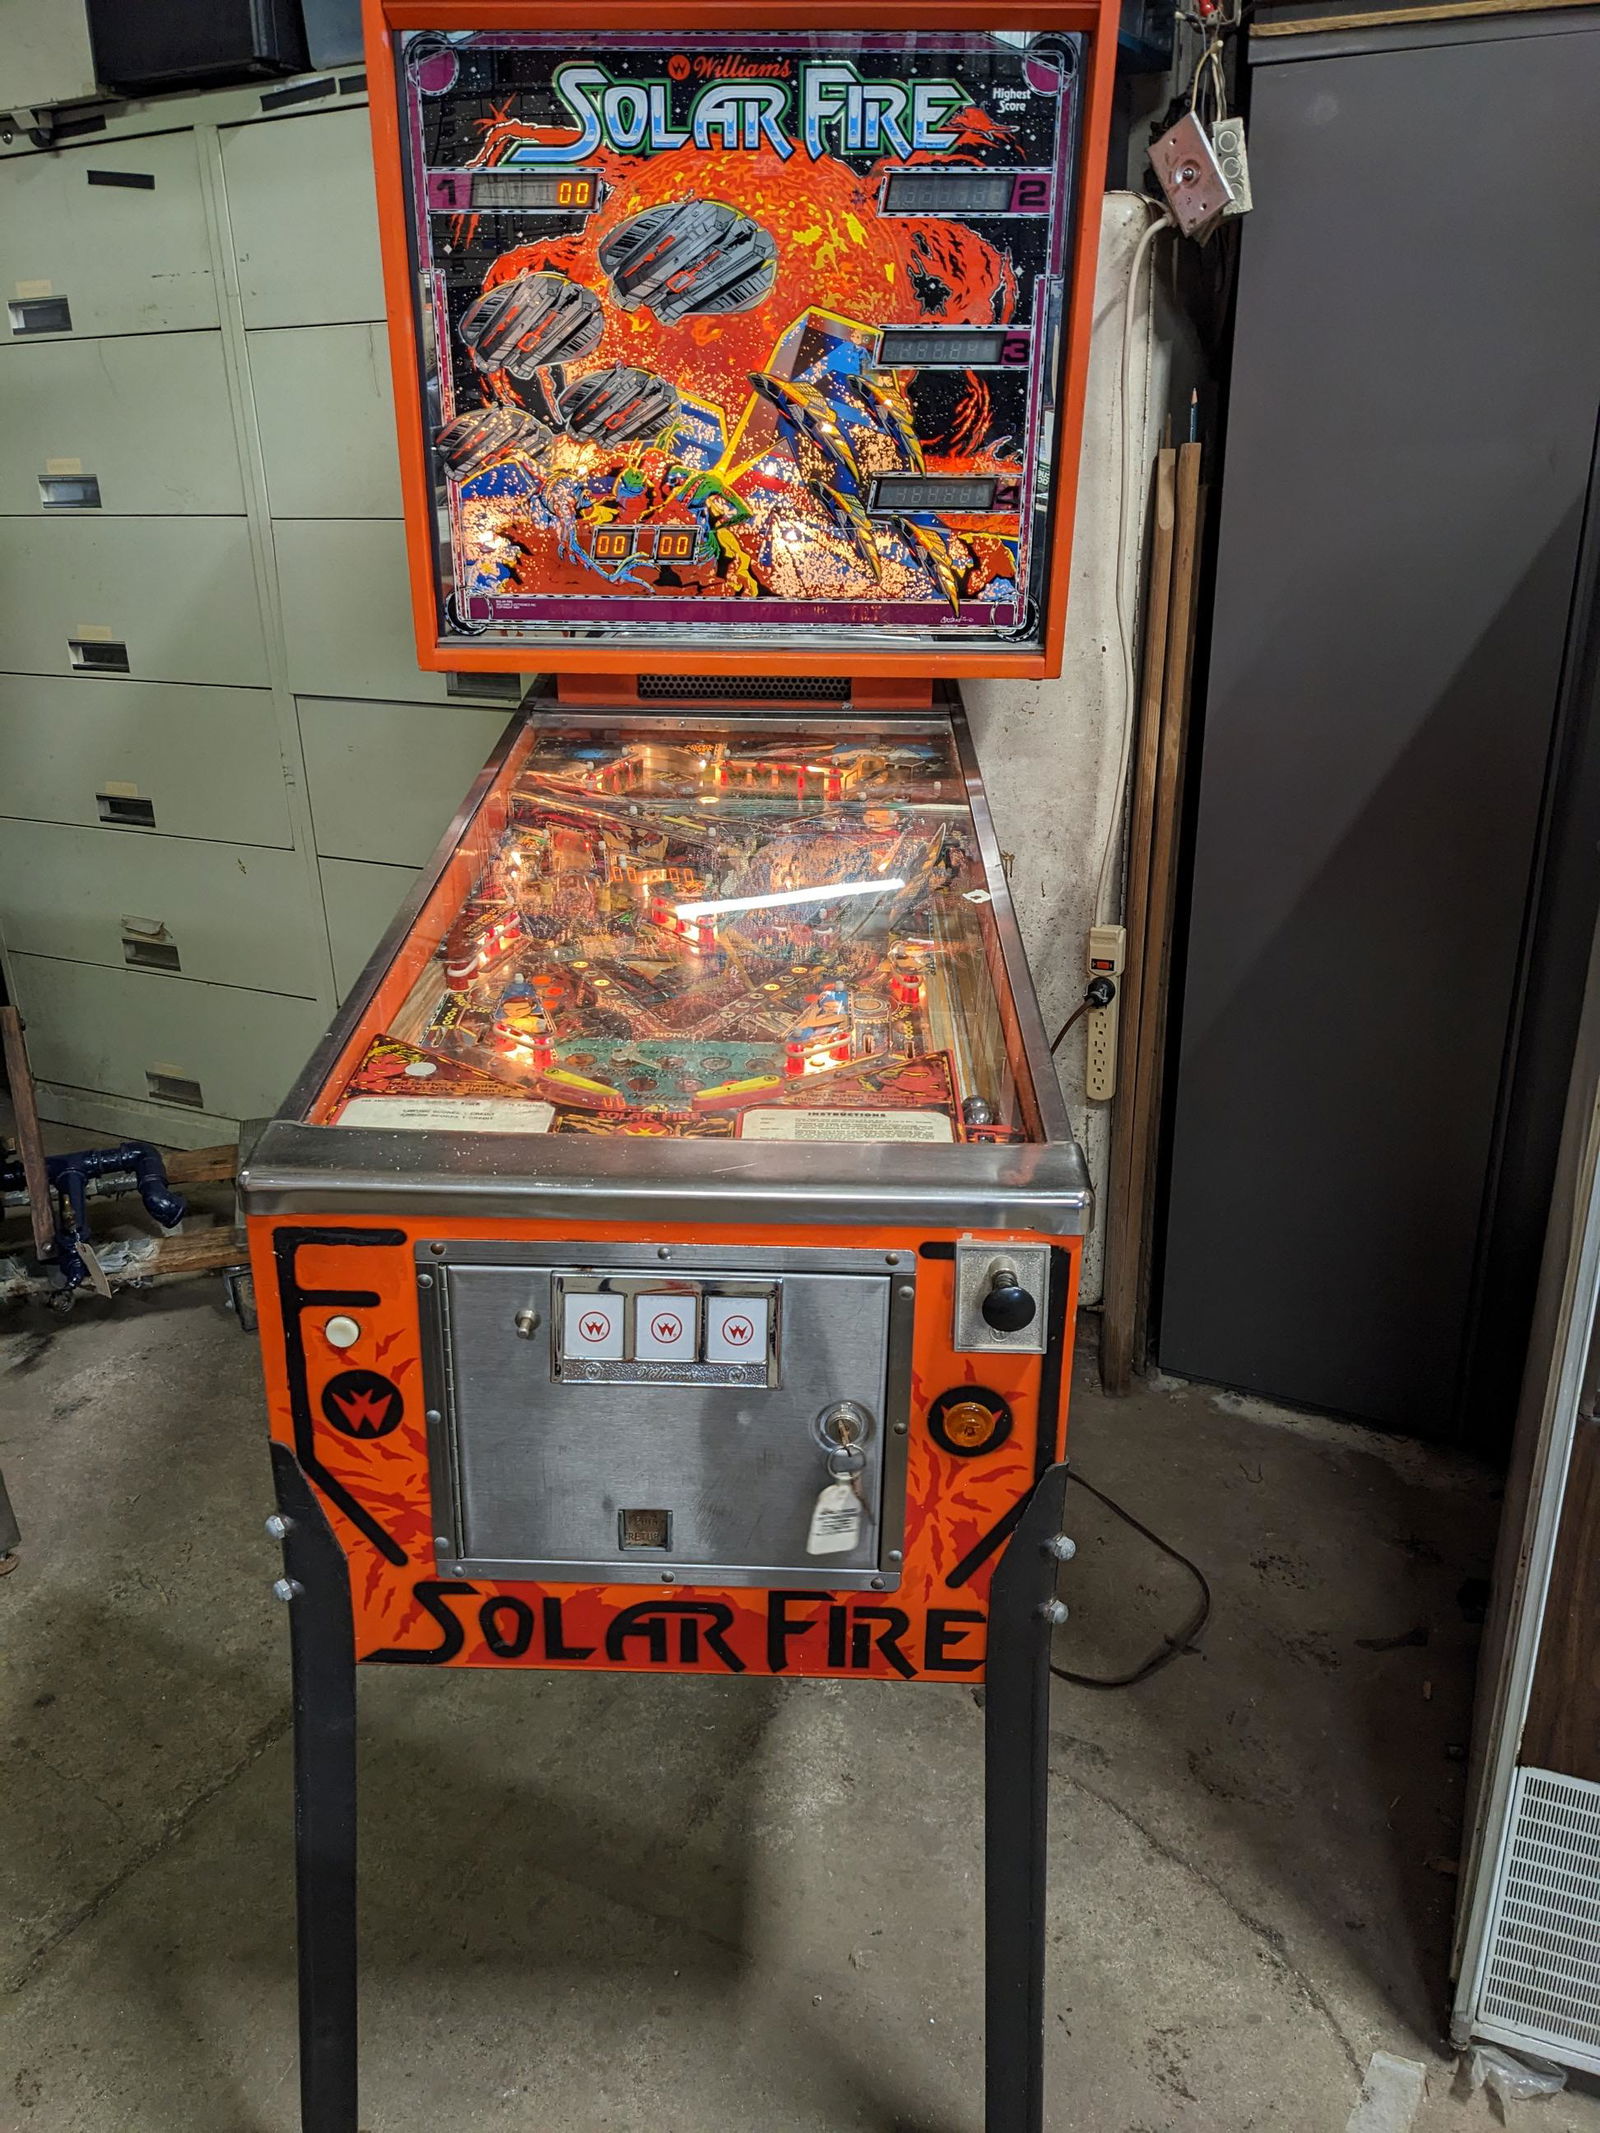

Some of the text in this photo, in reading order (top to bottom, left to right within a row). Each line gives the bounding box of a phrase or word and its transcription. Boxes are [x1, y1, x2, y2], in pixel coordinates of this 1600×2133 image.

[694, 54, 792, 79] Williams
[992, 87, 1032, 101] Highest
[996, 100, 1026, 113] Score
[507, 62, 971, 163] SOLAR FIRE
[436, 179, 457, 205] 1
[559, 182, 589, 205] 00
[1019, 180, 1046, 206] 2
[1002, 338, 1031, 363] 3
[996, 485, 1021, 505] 4
[597, 1111, 702, 1121] SOLAR FIRE
[361, 1581, 987, 1680] SOLAR FIRE
